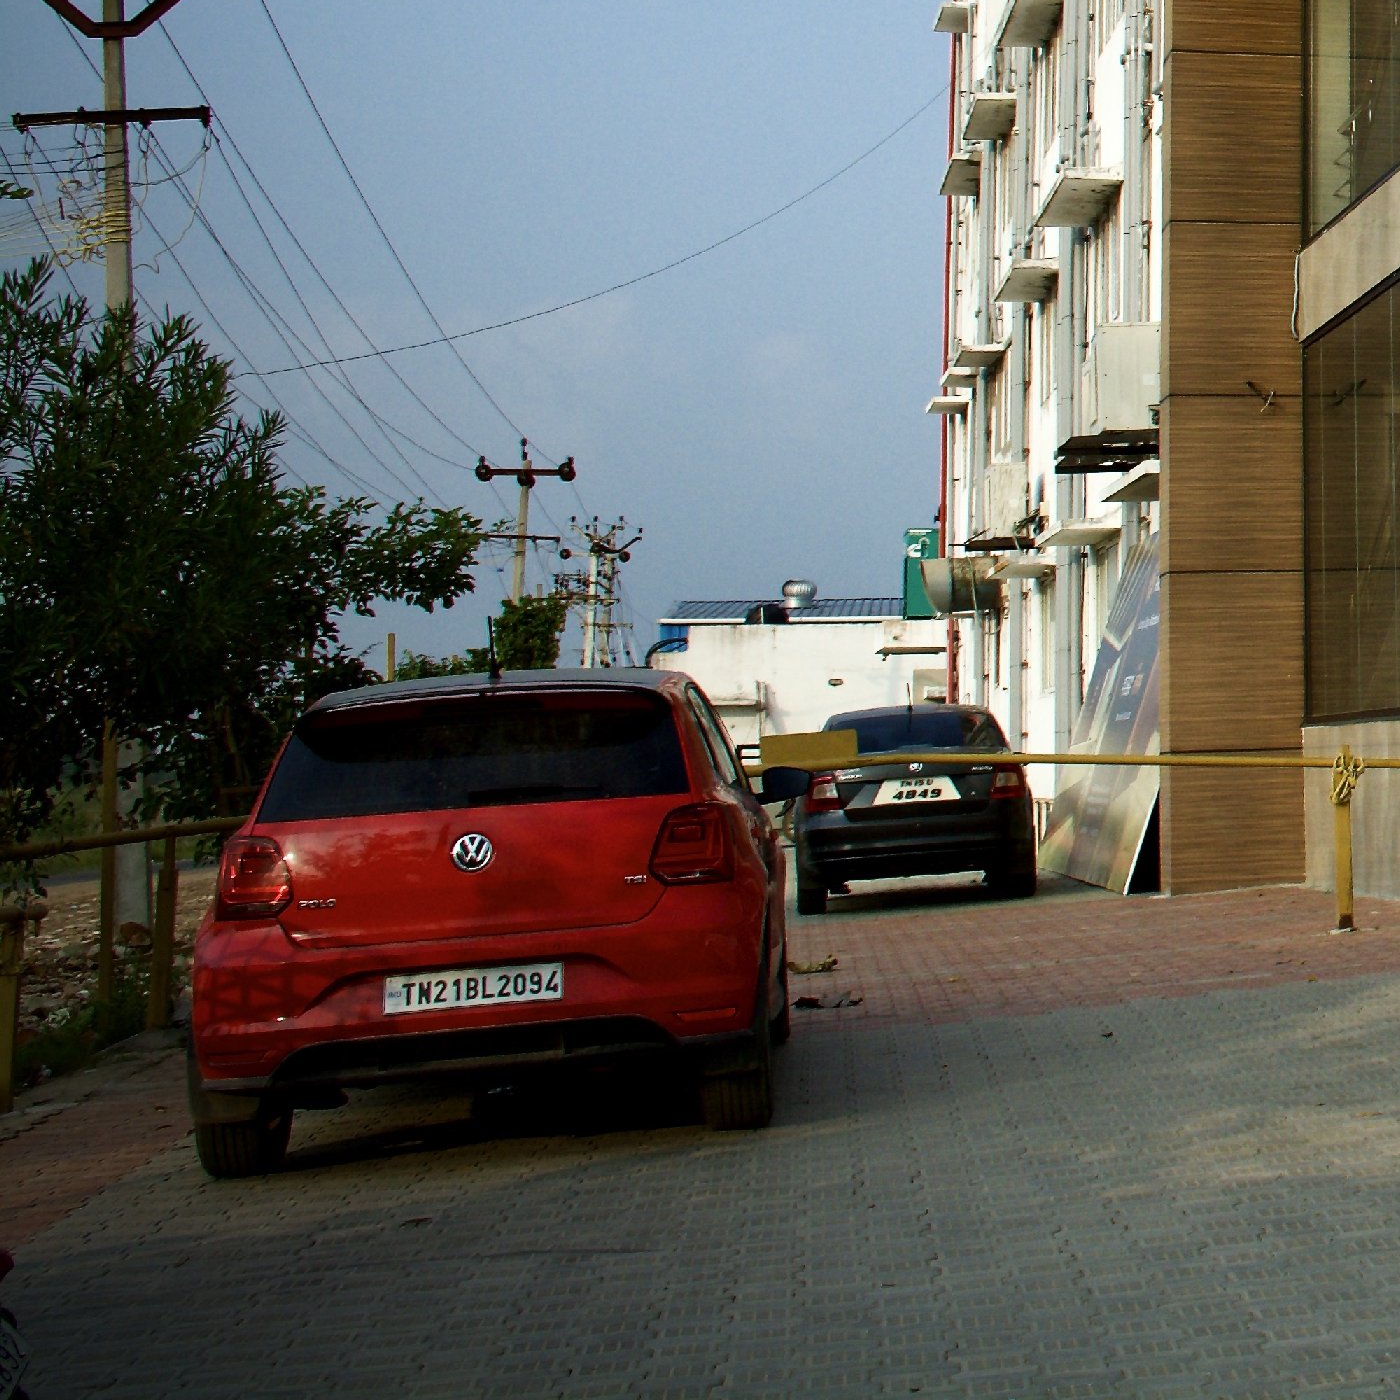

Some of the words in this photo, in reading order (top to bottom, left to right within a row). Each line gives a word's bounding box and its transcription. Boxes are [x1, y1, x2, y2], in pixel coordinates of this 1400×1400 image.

[893, 788, 942, 800] 4849
[298, 898, 337, 909] POLO
[402, 970, 559, 1007] TN21BL2094
